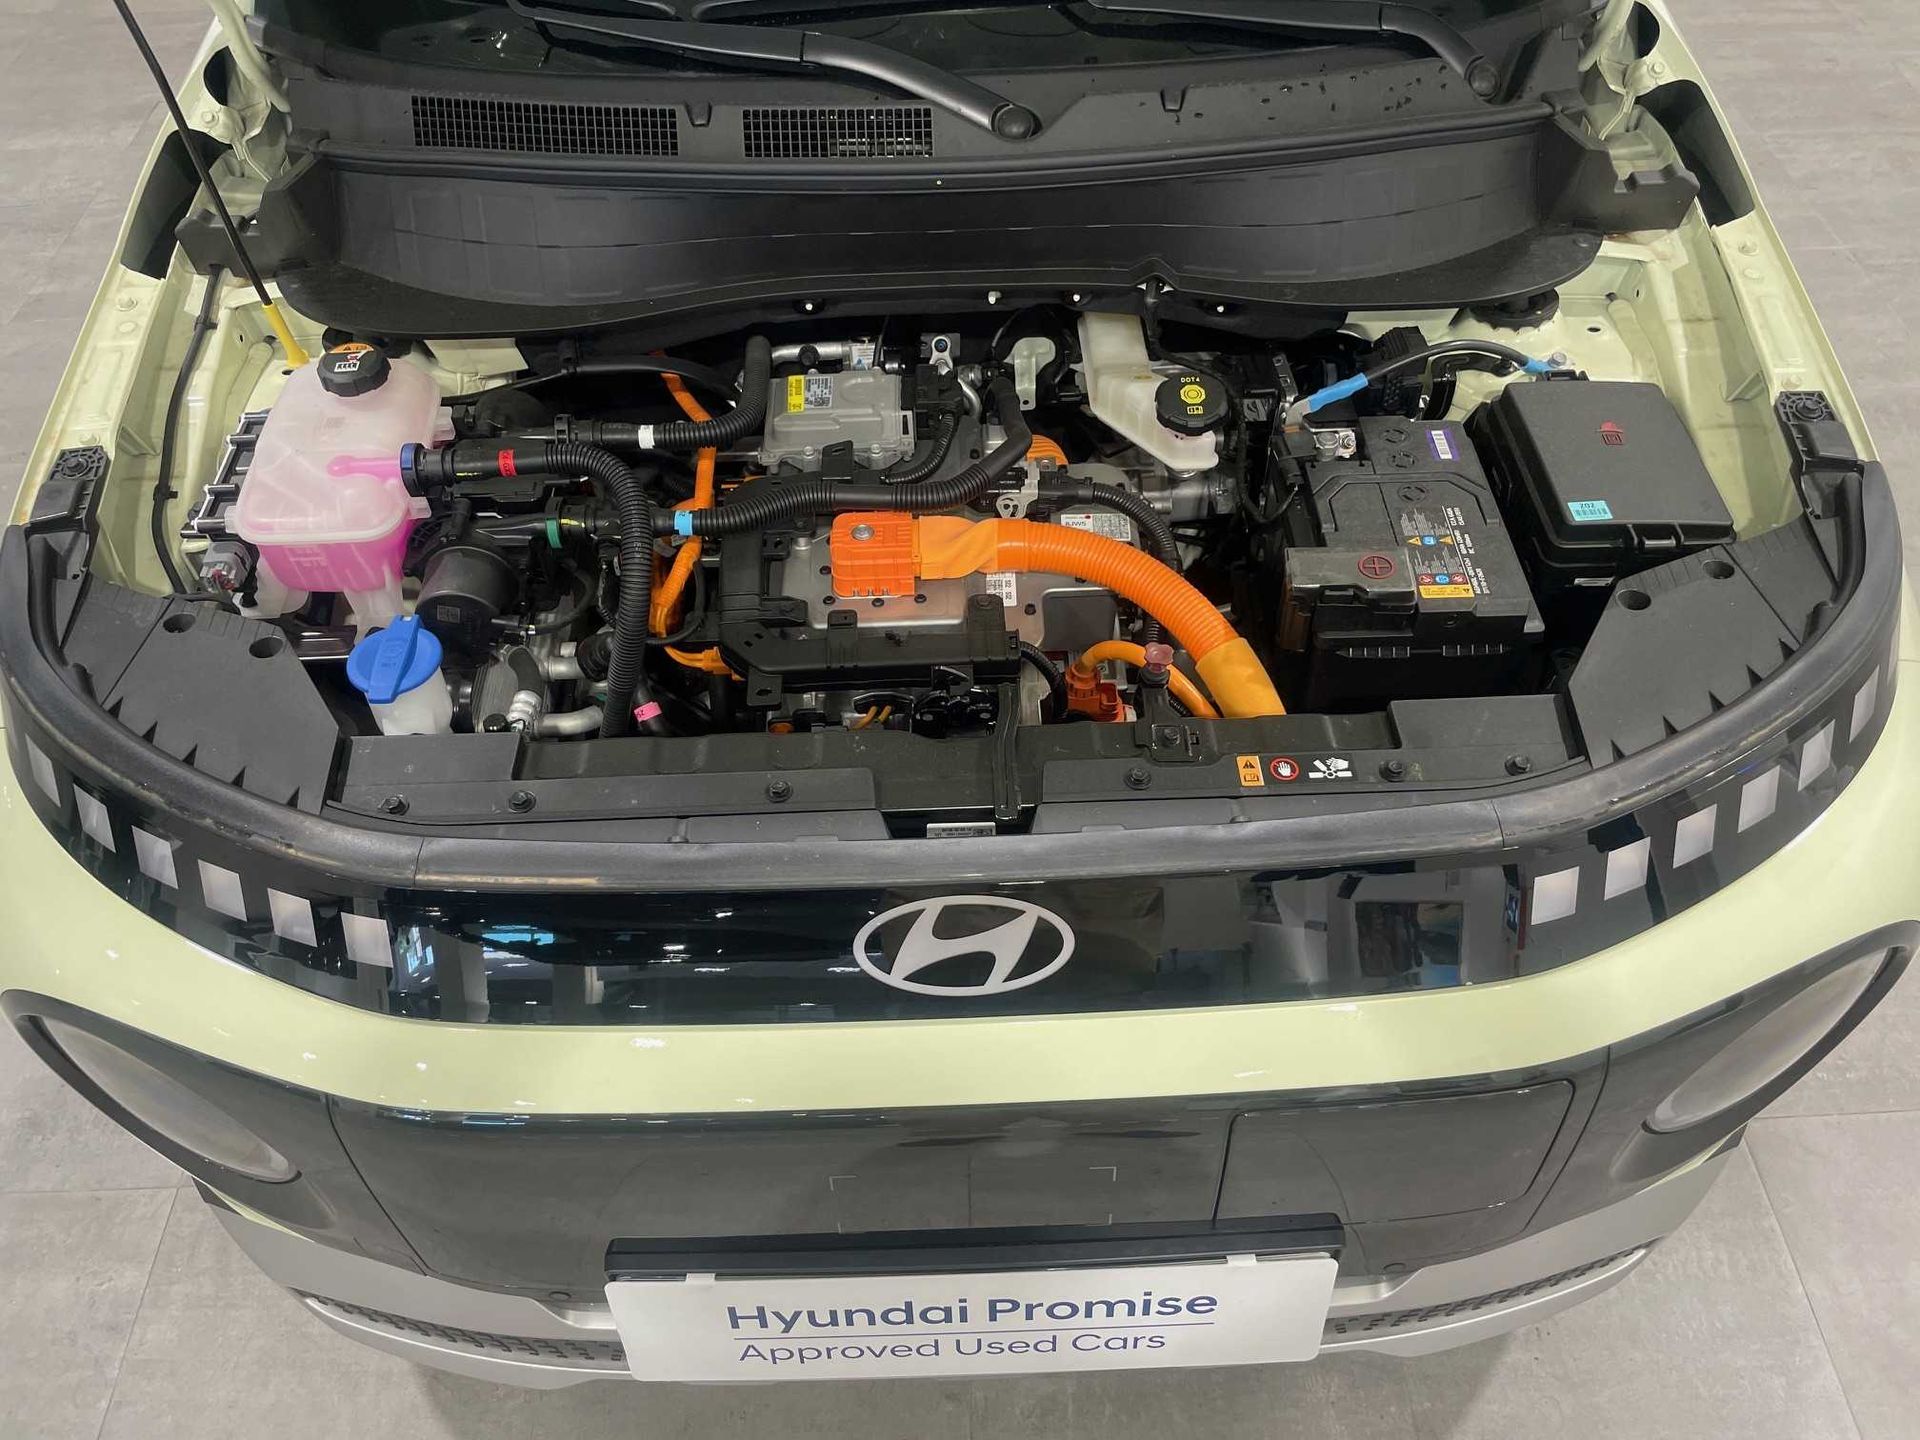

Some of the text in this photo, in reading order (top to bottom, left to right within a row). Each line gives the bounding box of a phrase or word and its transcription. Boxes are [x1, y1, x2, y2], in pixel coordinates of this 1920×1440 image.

[727, 1291, 1218, 1333] Hyundai Promise
[739, 1333, 1166, 1364] Approved Used Cars
